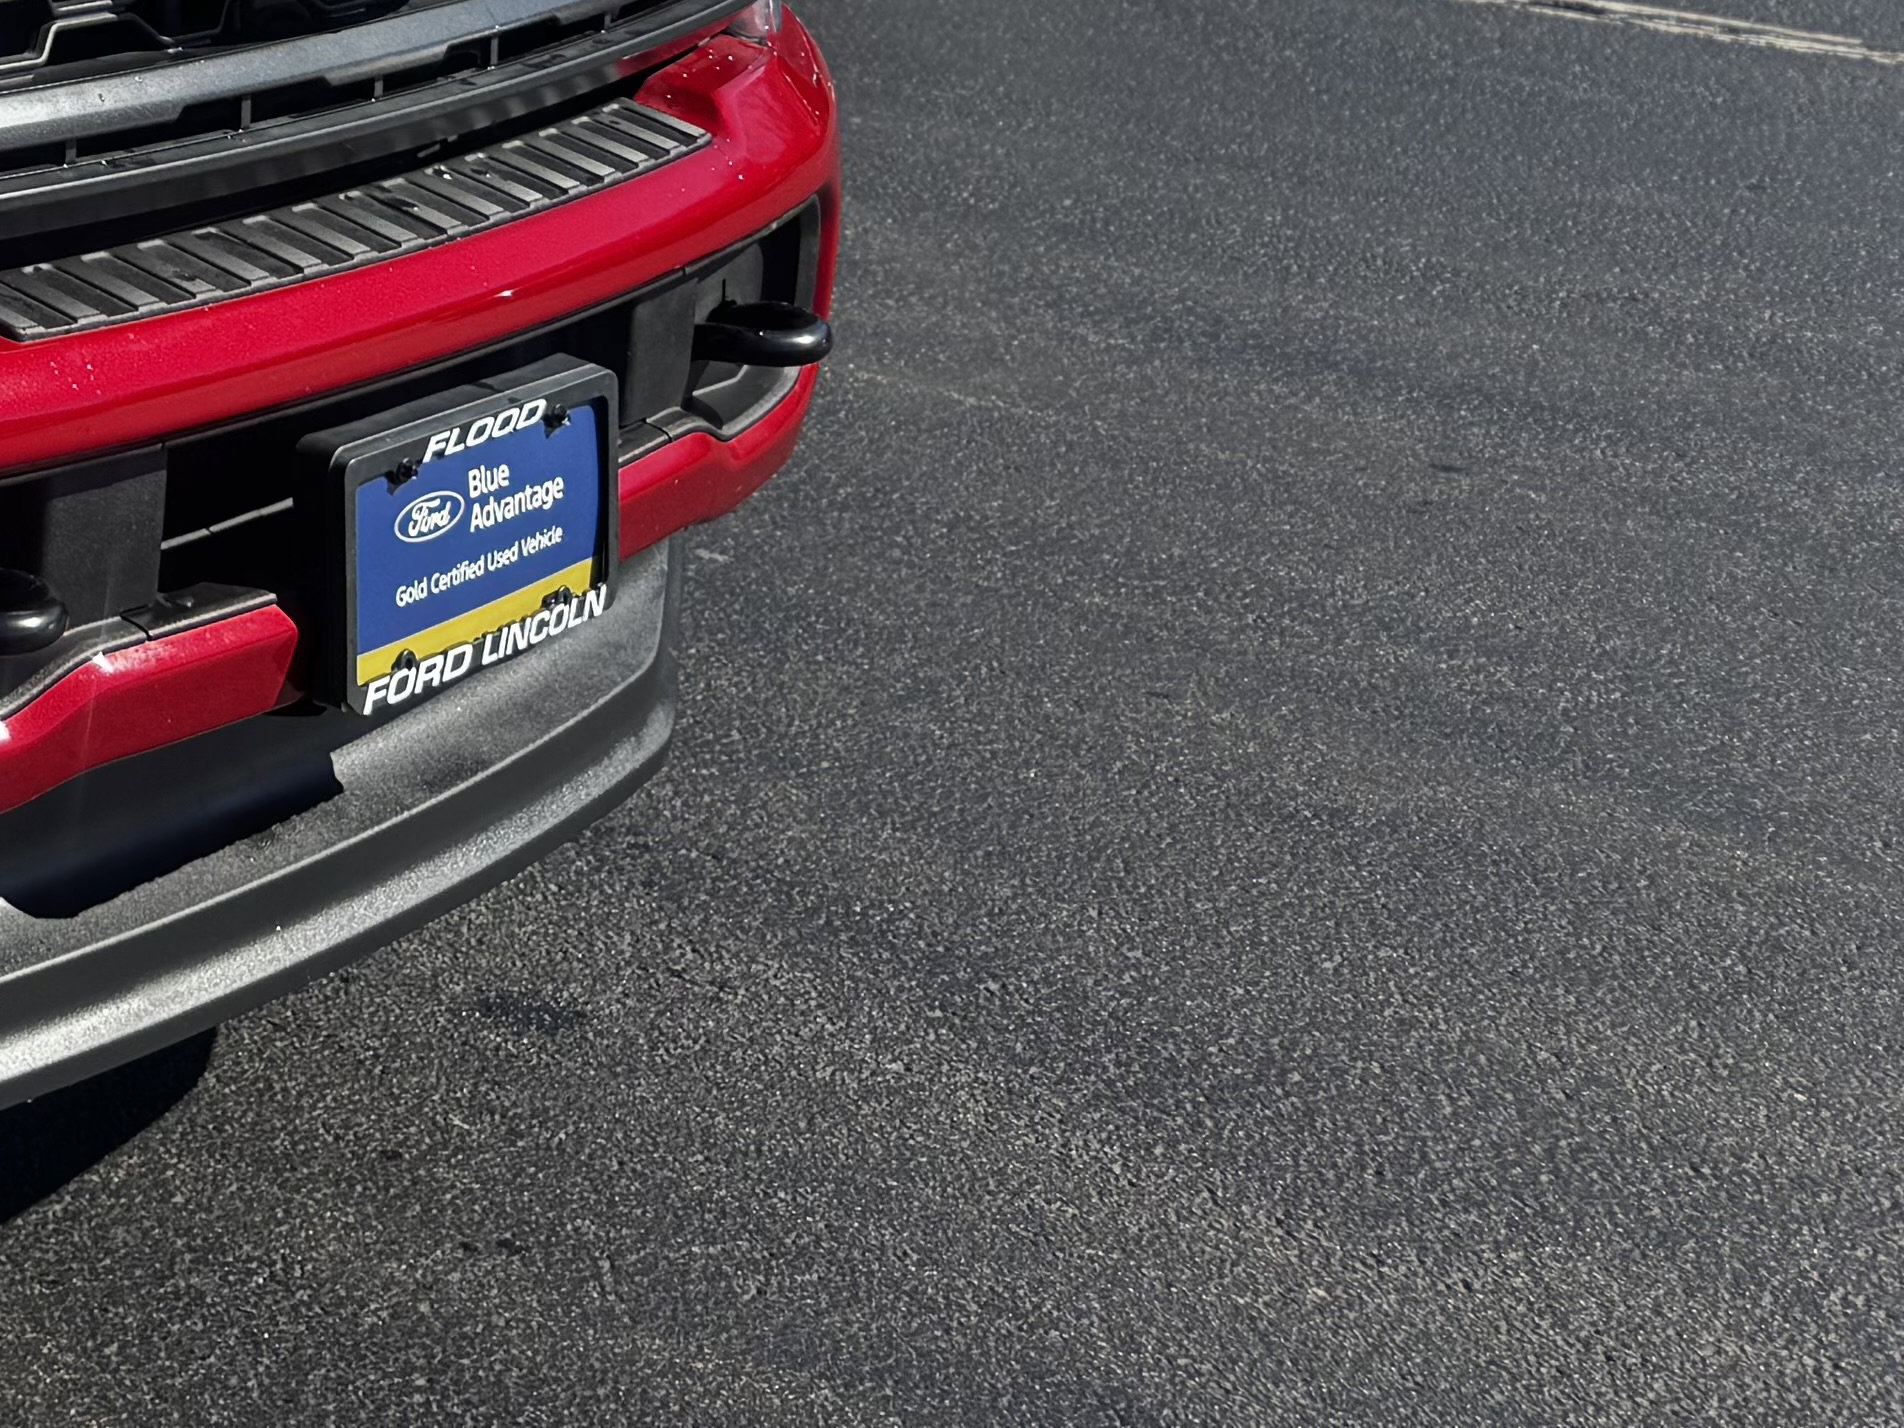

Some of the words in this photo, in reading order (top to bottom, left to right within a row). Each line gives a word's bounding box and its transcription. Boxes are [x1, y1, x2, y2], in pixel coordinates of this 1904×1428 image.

[423, 398, 547, 463] FLOOD
[408, 498, 452, 537] Ford
[470, 477, 564, 533] Advantage
[468, 464, 510, 498] Blue
[395, 577, 428, 607] Gold
[430, 555, 485, 594] Certified
[487, 541, 519, 571] Used
[521, 525, 563, 558] Vehicle
[363, 643, 474, 716] FORD
[481, 583, 607, 666] LINCOLN
